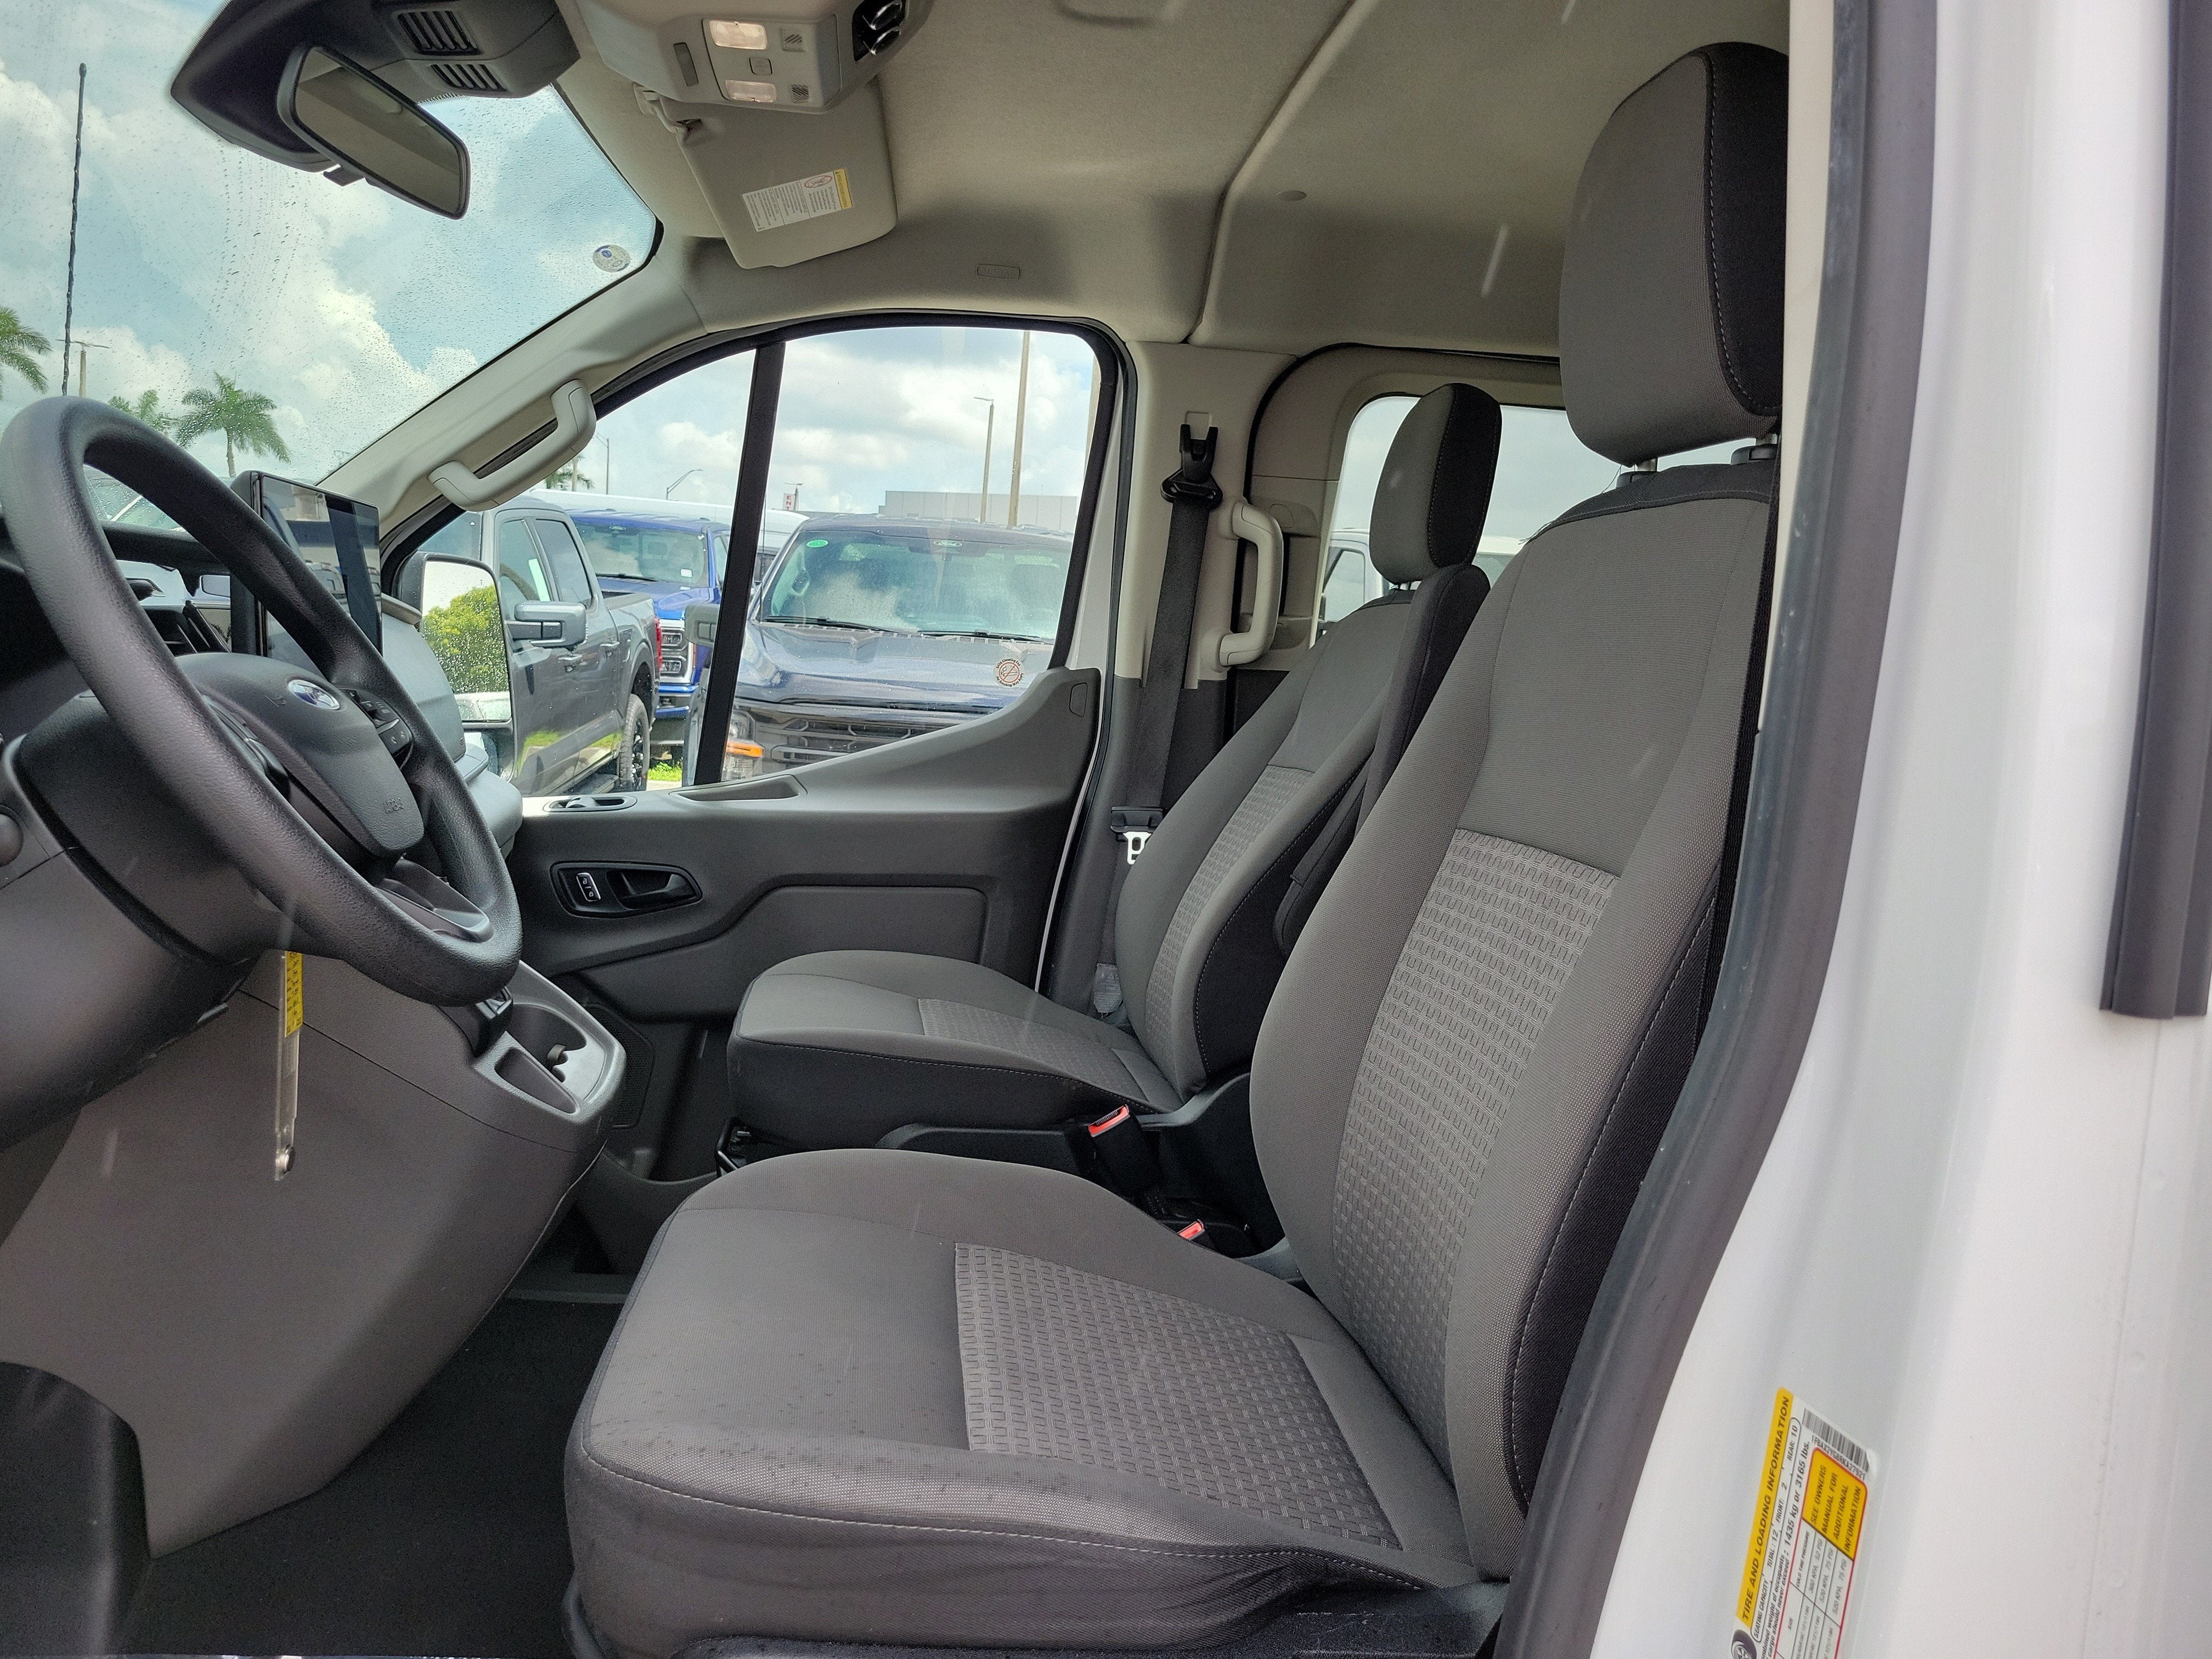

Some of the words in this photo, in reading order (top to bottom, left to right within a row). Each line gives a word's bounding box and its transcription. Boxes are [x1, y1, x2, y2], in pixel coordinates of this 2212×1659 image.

[1801, 1442, 1809, 1459] lbs.
[1795, 1461, 1805, 1488] 3165
[1815, 1466, 1826, 1504] OWNERS
[1742, 1589, 1753, 1620] TIRE
[1750, 1558, 1759, 1587] AND
[1756, 1496, 1771, 1555] LOADING
[1767, 1397, 1788, 1490] INFORMATION
[1794, 1490, 1800, 1502] or
[1822, 1496, 1833, 1533] MANUAL
[1829, 1473, 1837, 1492] FOR
[1790, 1504, 1798, 1518] kg
[1833, 1486, 1848, 1539] ADDITIONAL
[1844, 1487, 1860, 1551] INFORMATION
[1753, 1611, 1763, 1638] SEATING
[1759, 1579, 1768, 1611] CAPACITY
[1771, 1529, 1778, 1541] 12
[1775, 1500, 1784, 1522] FRONT:
[1781, 1482, 1787, 1490] 2
[1791, 1425, 1798, 1437] 10
[1785, 1519, 1794, 1545] 1435
[1775, 1555, 1785, 1592] occupants
[1781, 1558, 1790, 1585] exceed
[1825, 1560, 1831, 1571] 75
[1838, 1571, 1844, 1581] 75
[1768, 1602, 1776, 1628] weight
